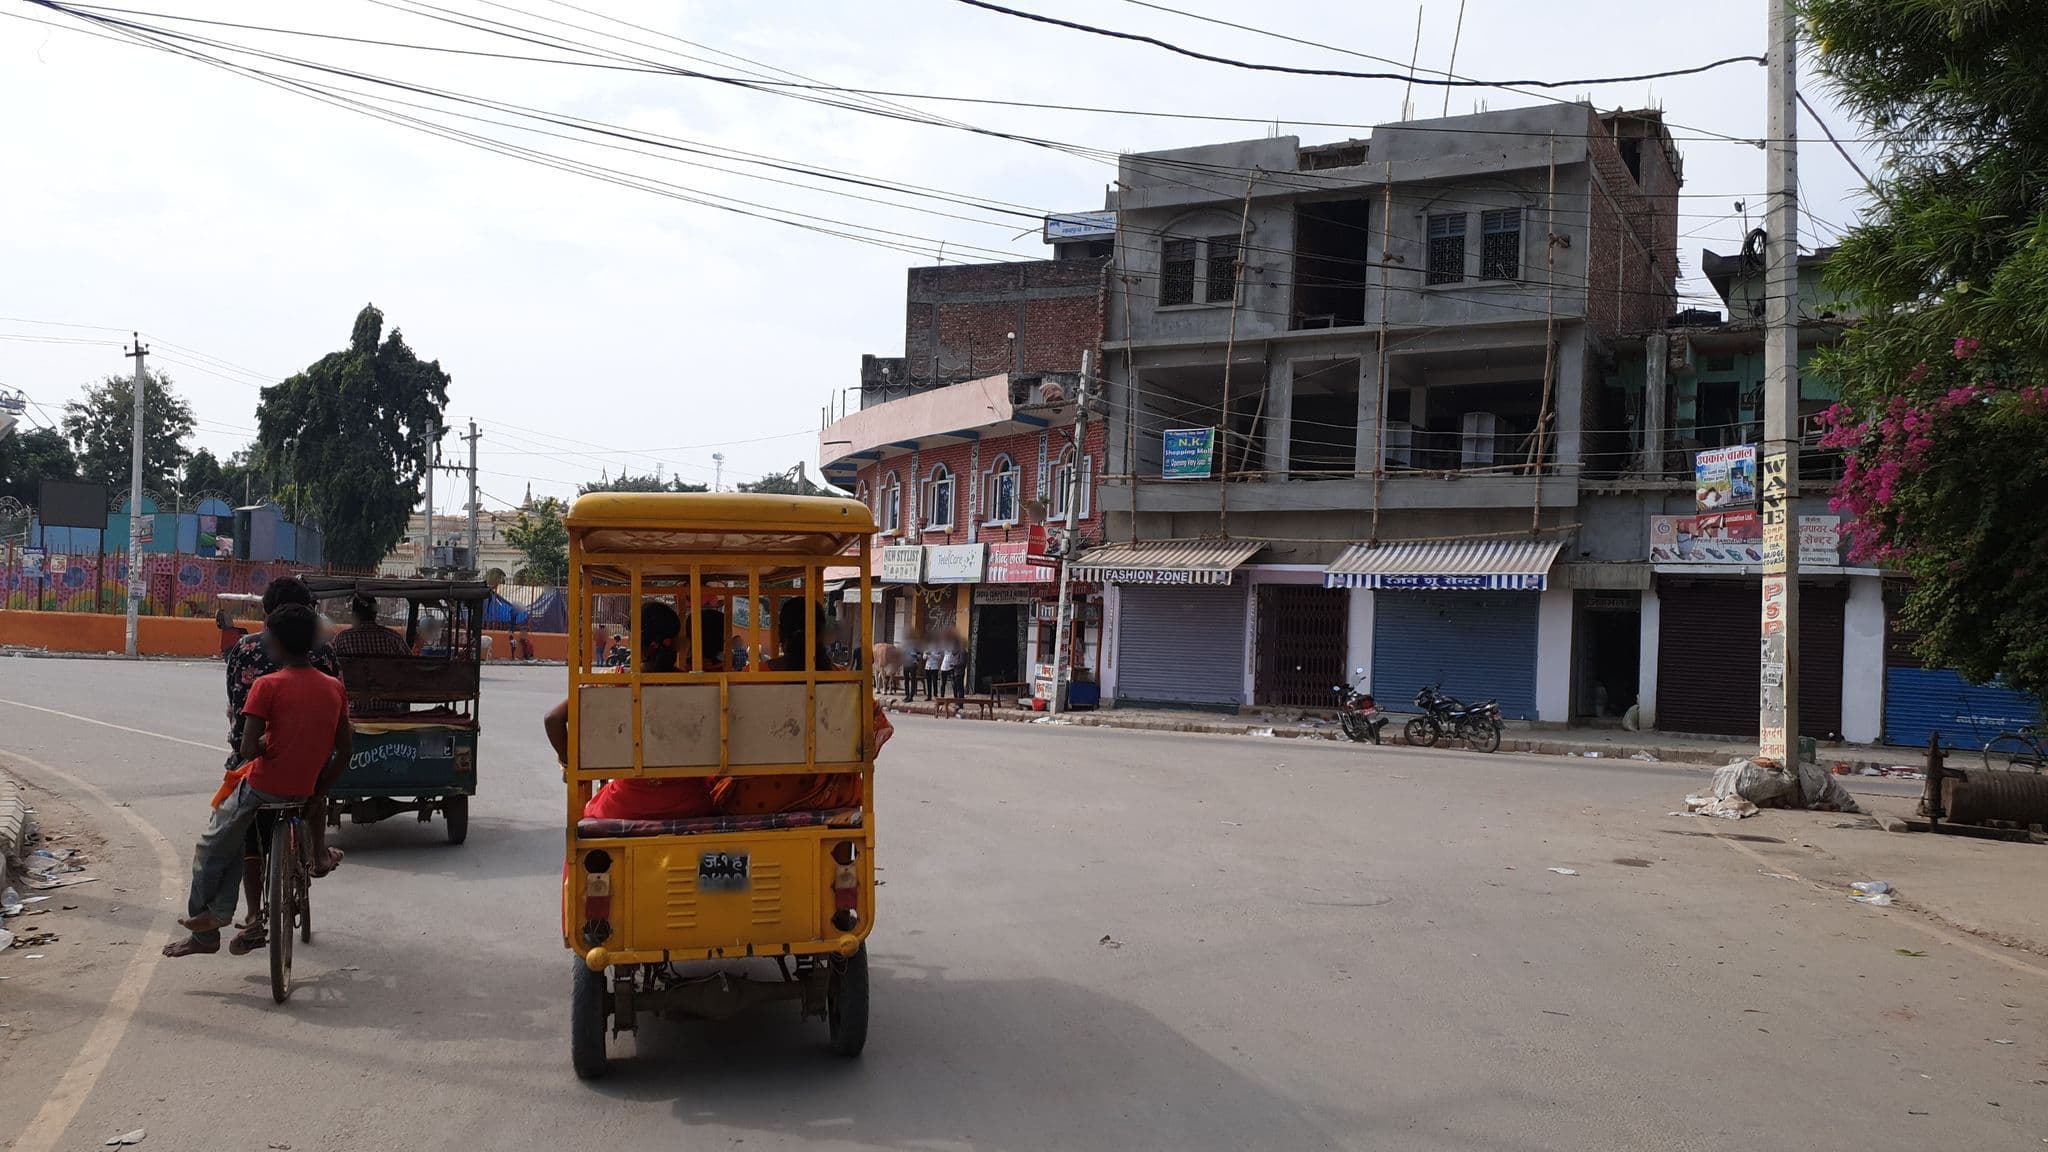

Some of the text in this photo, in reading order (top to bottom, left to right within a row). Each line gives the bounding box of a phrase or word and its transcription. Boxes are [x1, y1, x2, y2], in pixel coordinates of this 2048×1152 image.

[1179, 438, 1203, 447] N.K.
[1764, 459, 1786, 525] WAVE
[884, 549, 919, 562] NEW STYLIST
[1105, 570, 1188, 582] FASHION ZONE
